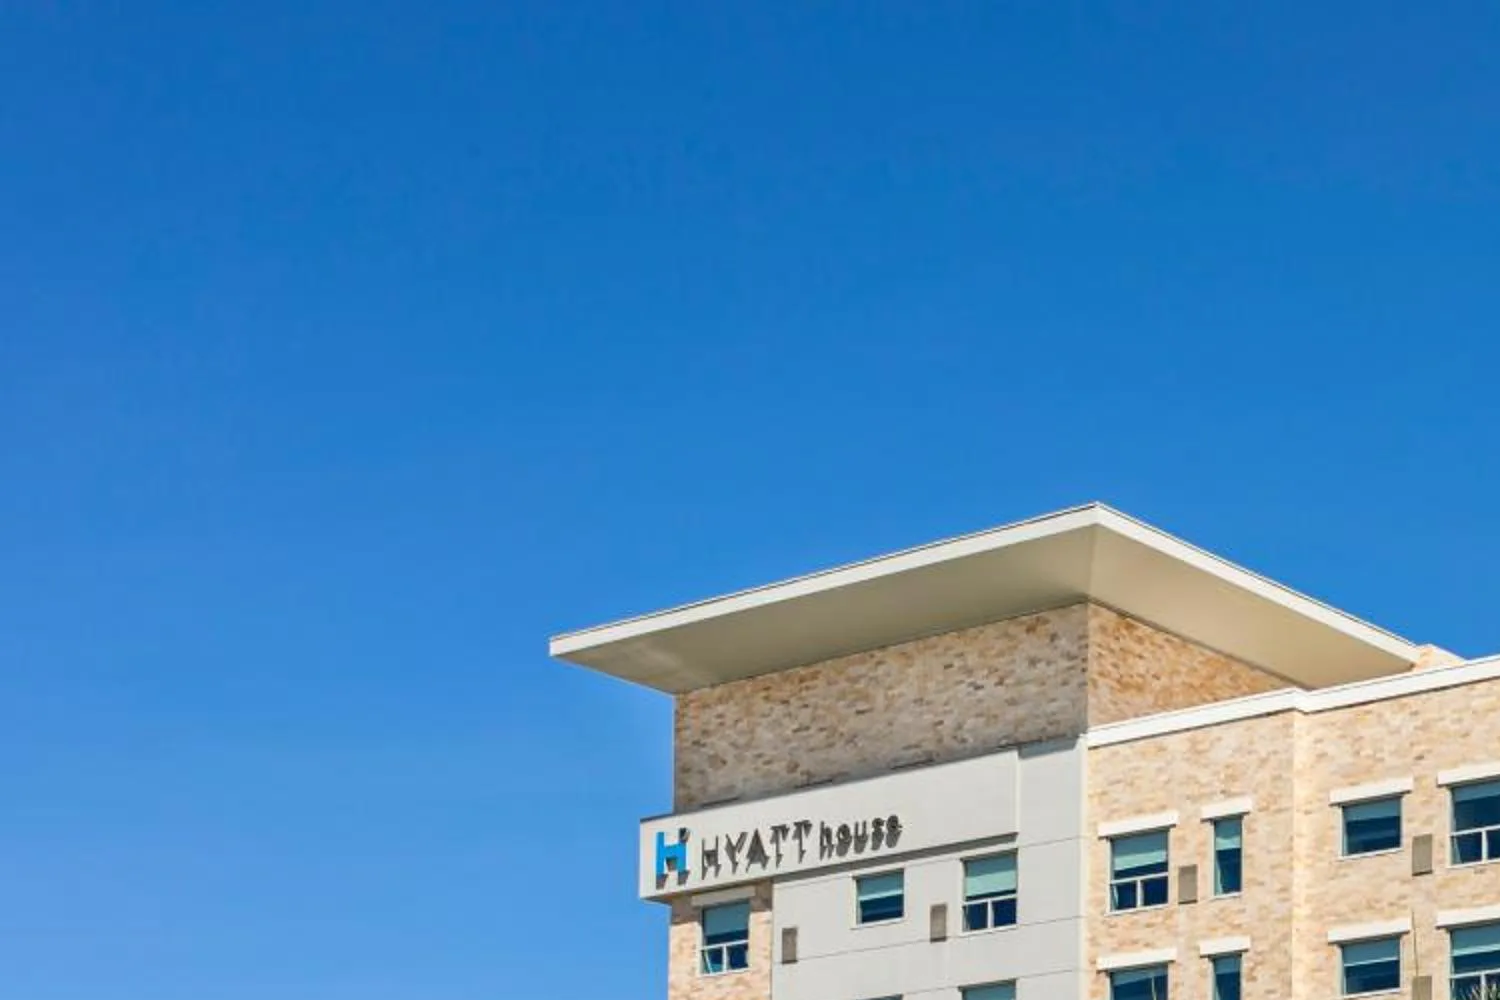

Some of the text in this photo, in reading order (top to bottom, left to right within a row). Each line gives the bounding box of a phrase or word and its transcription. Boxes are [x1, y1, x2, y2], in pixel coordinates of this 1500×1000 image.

[656, 814, 901, 886] H HYATT house
